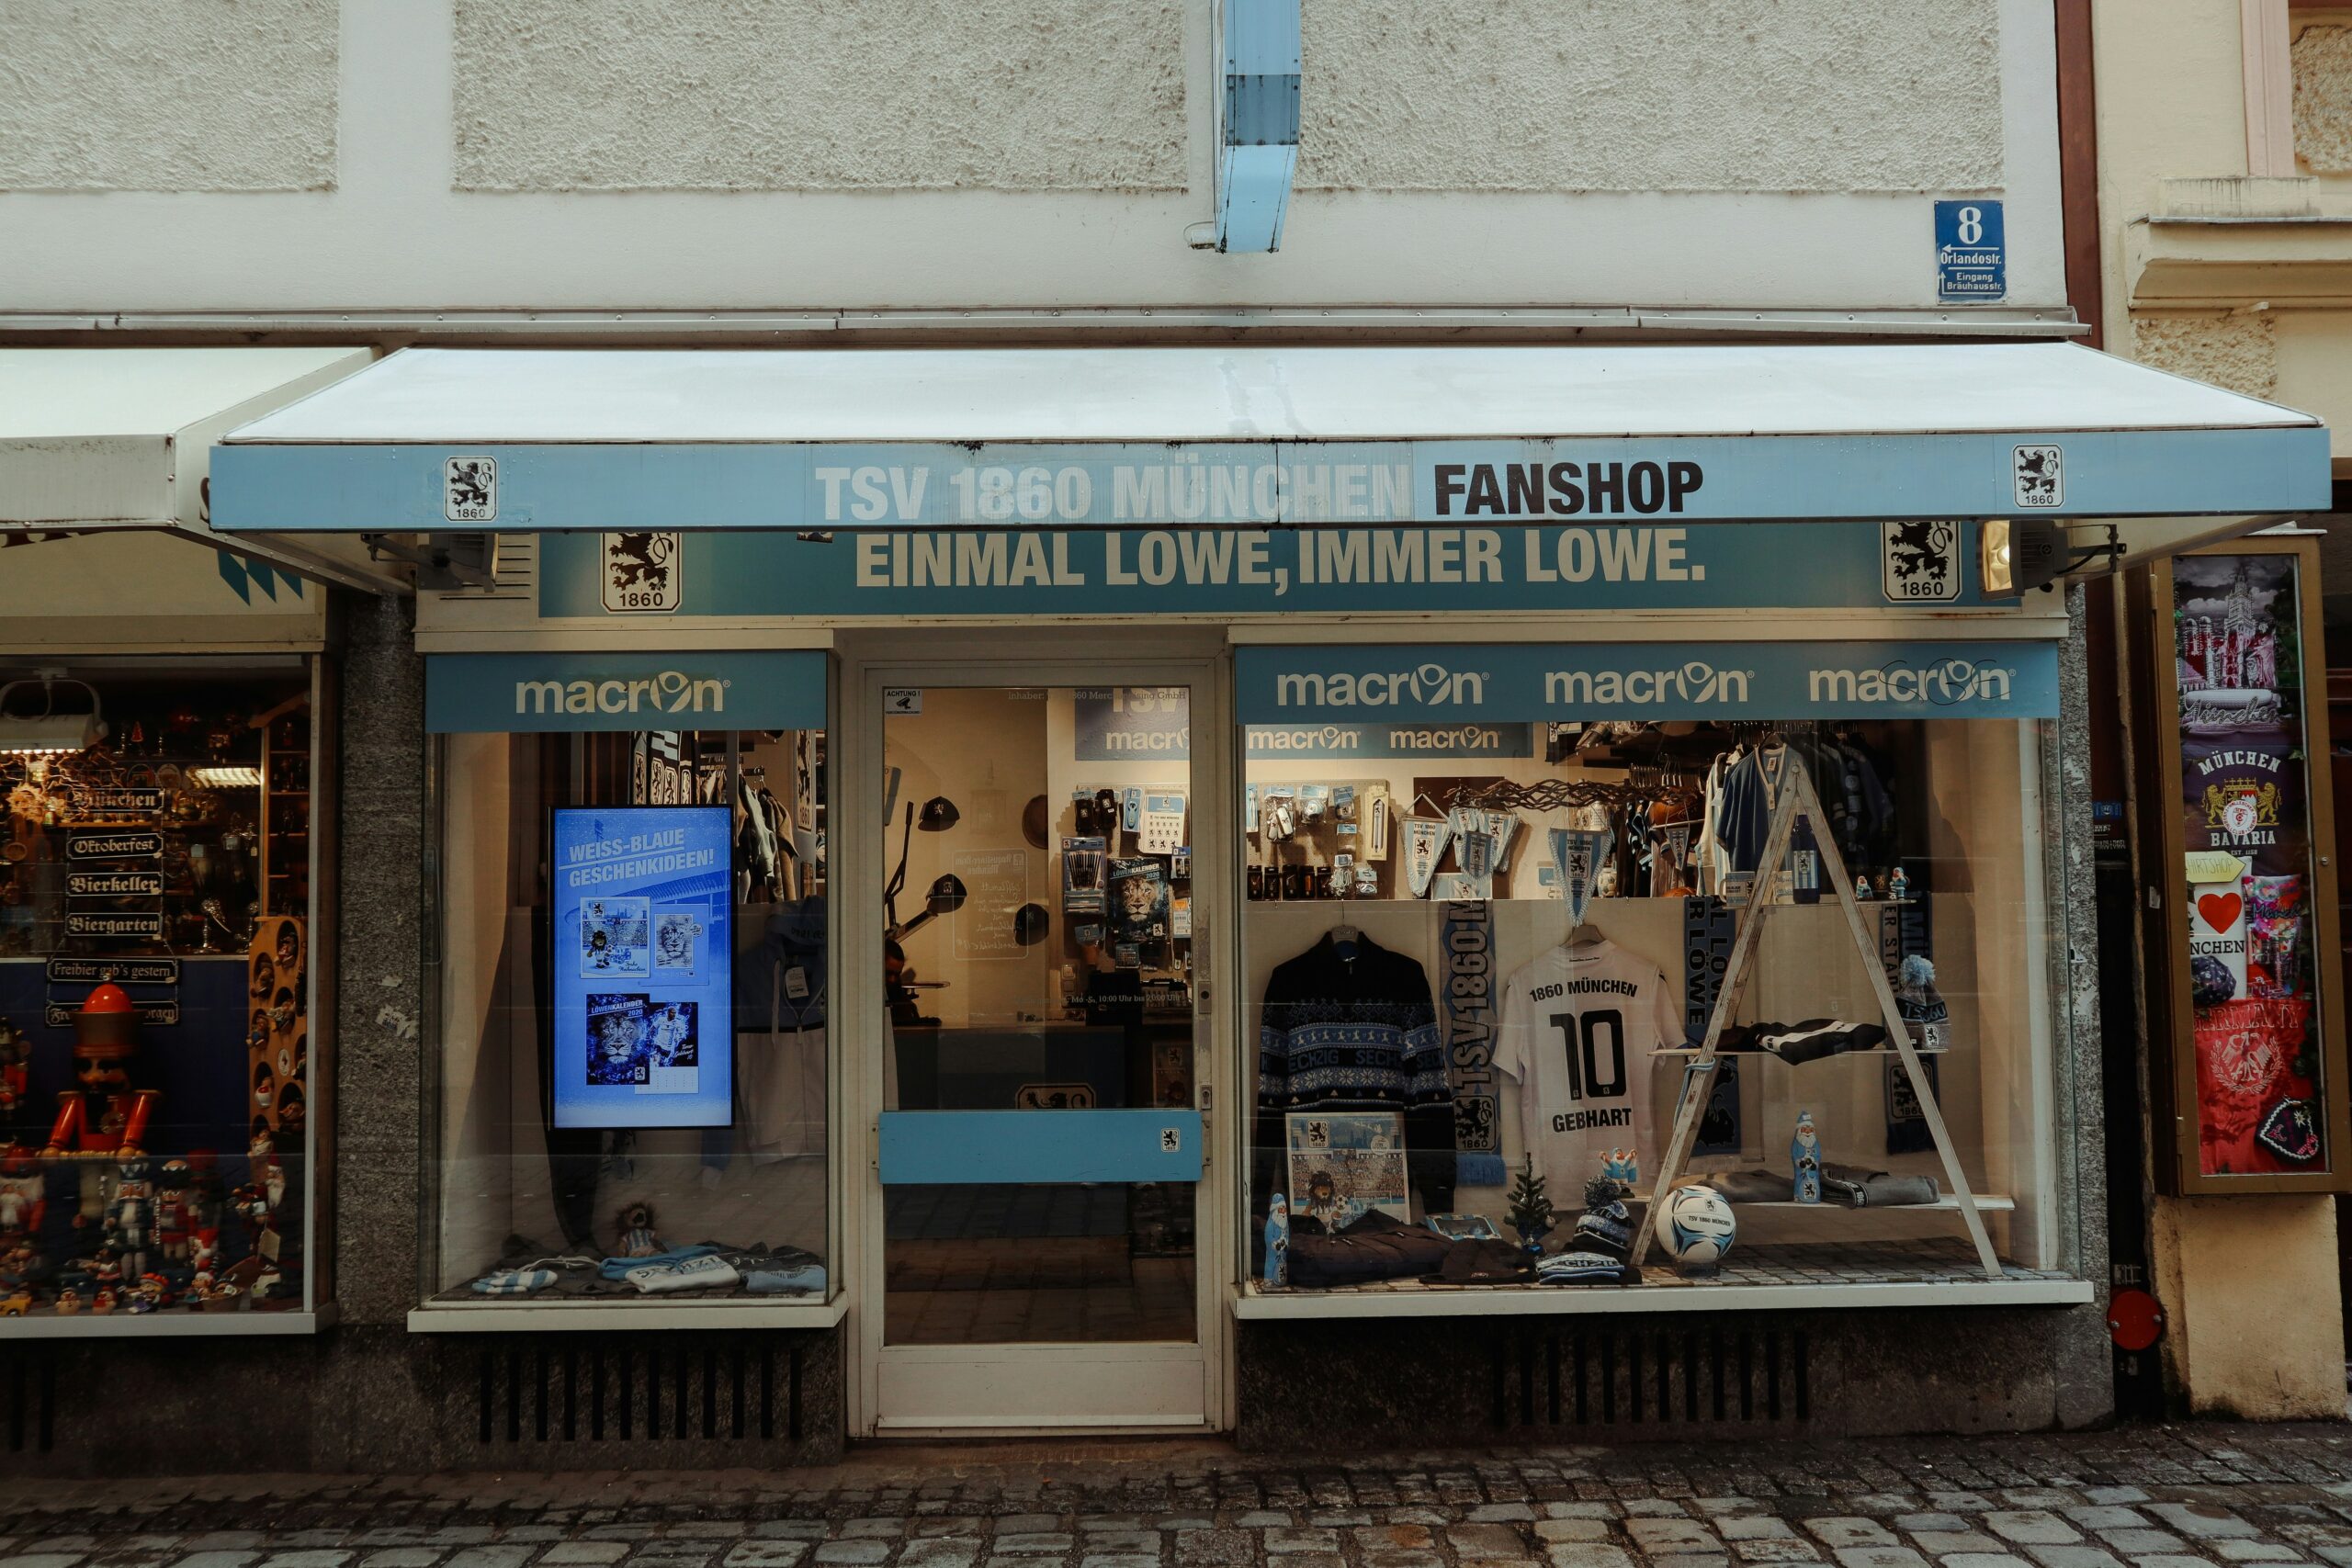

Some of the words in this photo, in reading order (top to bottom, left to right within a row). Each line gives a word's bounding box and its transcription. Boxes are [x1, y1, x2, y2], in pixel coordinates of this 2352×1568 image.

[1958, 207, 1983, 244] 8
[1940, 252, 2002, 265] Orlandostr.
[1947, 281, 2002, 290] Bräuhausstr.
[1956, 273, 1993, 282] Eingang
[816, 467, 928, 521] TSV
[950, 465, 1091, 521] 1860
[1113, 453, 1411, 518] MÜNCHEN
[1434, 461, 1703, 515] FANSHOP
[2024, 494, 2054, 504] 1860
[455, 508, 486, 519] 1860
[855, 533, 1085, 588] EINMAL
[1298, 528, 1504, 585] IMMER
[1900, 581, 1944, 596] 1860
[618, 592, 664, 608] 1860
[1157, 691, 1186, 700] GmbH
[1248, 726, 1358, 750] macron
[1390, 724, 1499, 749] macron
[2198, 750, 2282, 776] MÜNCHEN
[74, 839, 156, 854] Oktoberfest
[570, 828, 685, 863] WEISS-BLAUE
[2211, 829, 2277, 847] BAVARIA
[570, 848, 715, 888] GESCHENKIDEEN!
[69, 875, 160, 894] Bierkeller
[69, 916, 159, 935] Biergarten
[2189, 940, 2245, 955] NCHEN
[54, 964, 96, 977] Freibier
[130, 966, 171, 981] gestern
[1449, 929, 1489, 1014] 1860
[1689, 929, 1710, 1025] LÖWE
[1118, 993, 1133, 1003] Uhr
[1529, 984, 1564, 1002] 1860
[1567, 976, 1638, 998] MÜNCHEN
[1451, 1019, 1492, 1090] TSV
[1549, 1009, 1627, 1101] 10
[1552, 1107, 1633, 1134] GEBHART
[1462, 1140, 1488, 1150] 1860
